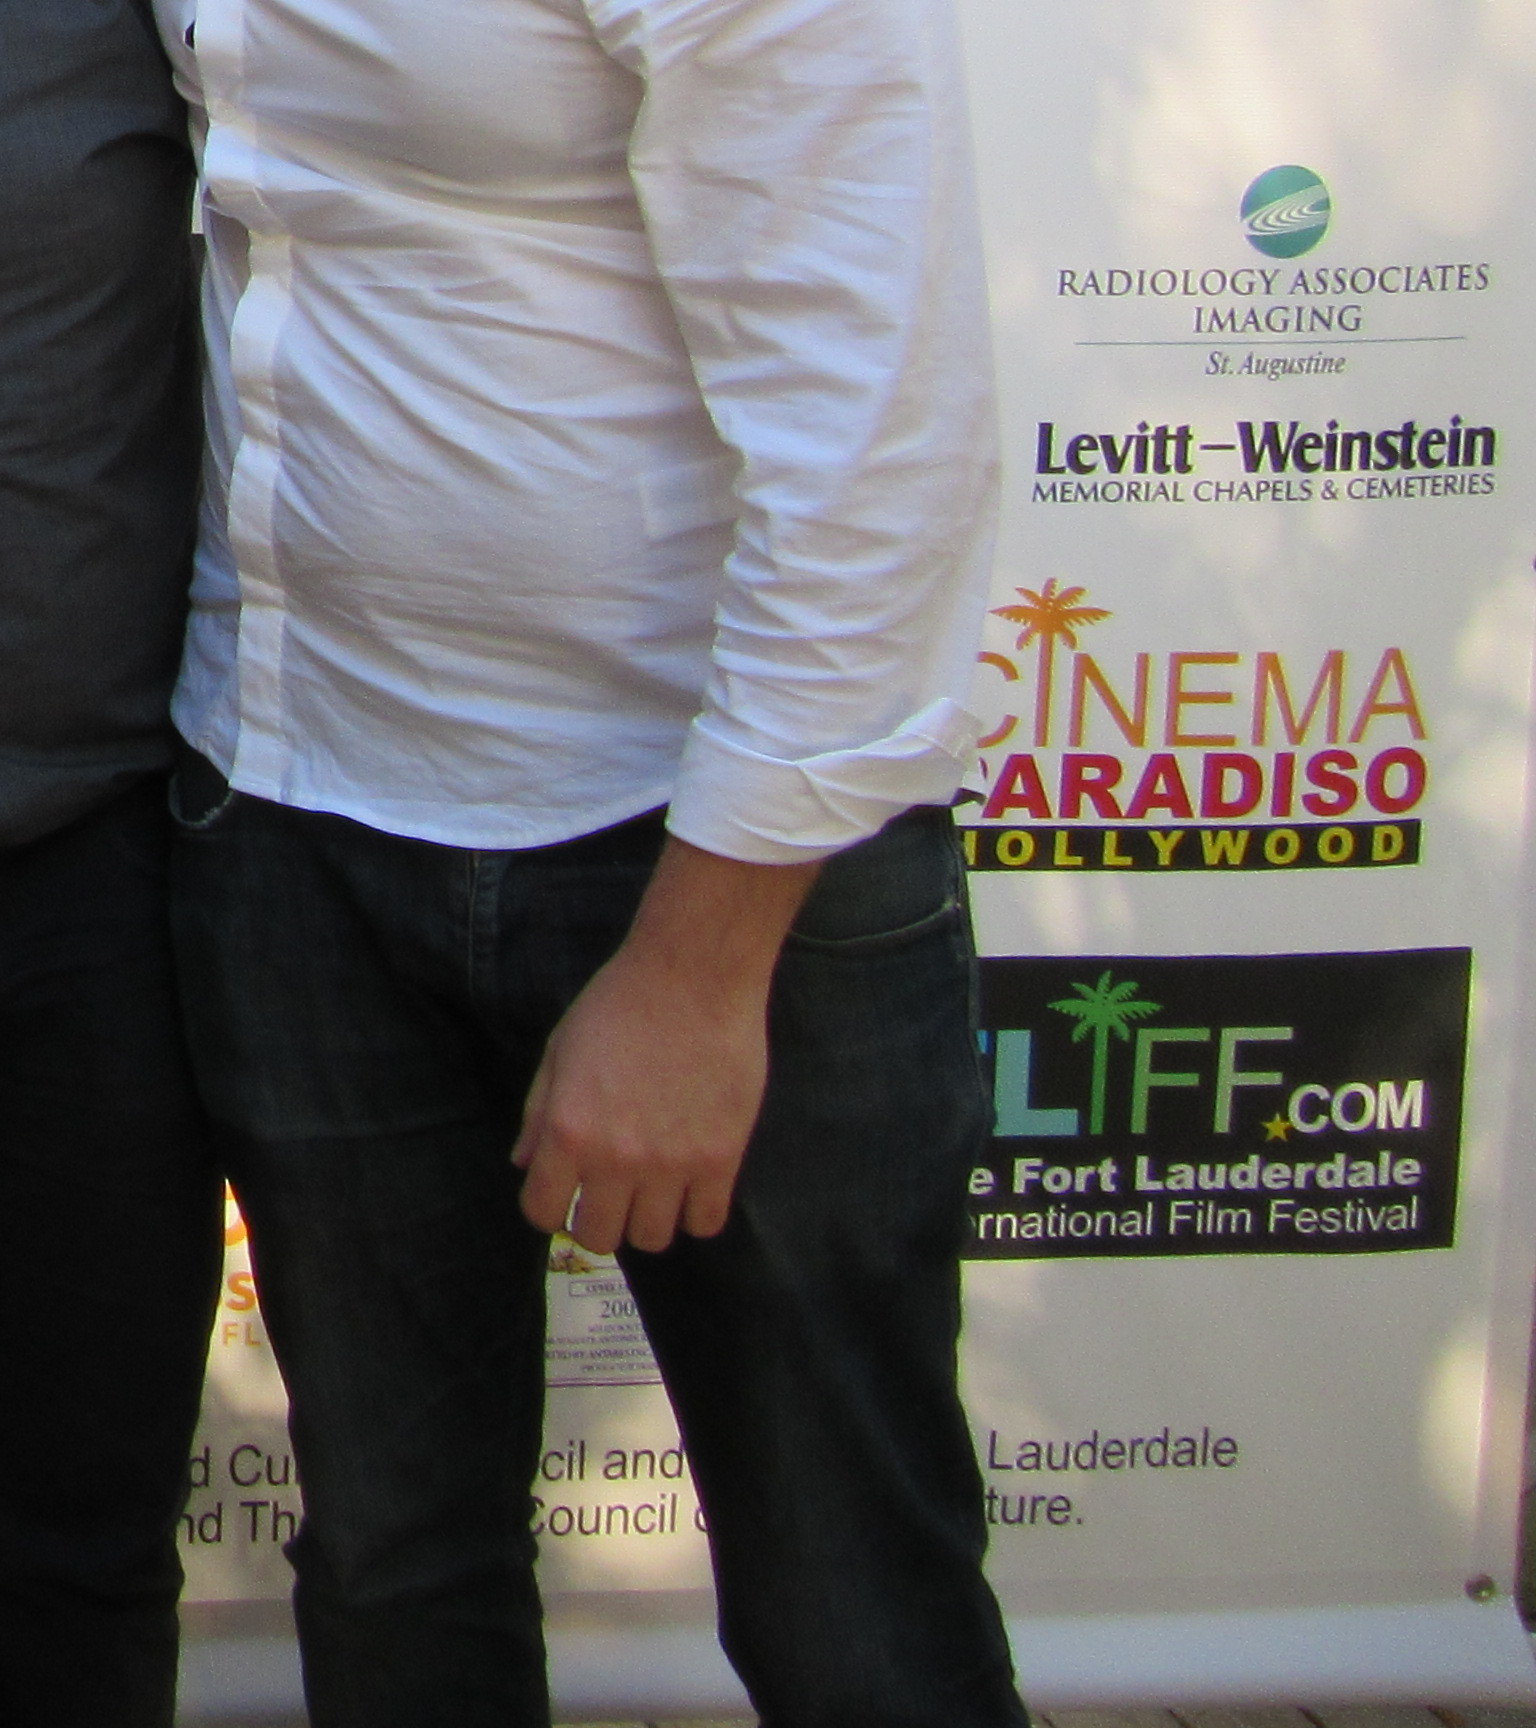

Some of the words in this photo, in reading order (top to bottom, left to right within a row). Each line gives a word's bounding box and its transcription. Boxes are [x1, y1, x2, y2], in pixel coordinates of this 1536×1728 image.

[1057, 268, 1281, 297] RADIOLOGY
[1289, 263, 1490, 294] ASSOCIATES
[1192, 304, 1363, 333] IMAGING
[1205, 352, 1233, 375] St.
[1238, 353, 1346, 381] Augustine
[1031, 480, 1185, 503] MEMORIAL
[1193, 479, 1312, 501] CHAPELS
[1321, 479, 1338, 500] &
[1346, 473, 1496, 500] CEMETERIES
[1013, 1157, 1119, 1196] Fort
[1134, 1152, 1422, 1193] Lauderdale
[1168, 1201, 1253, 1237] Film
[1269, 1196, 1419, 1234] Festival
[987, 1427, 1239, 1472] Lauderdale
